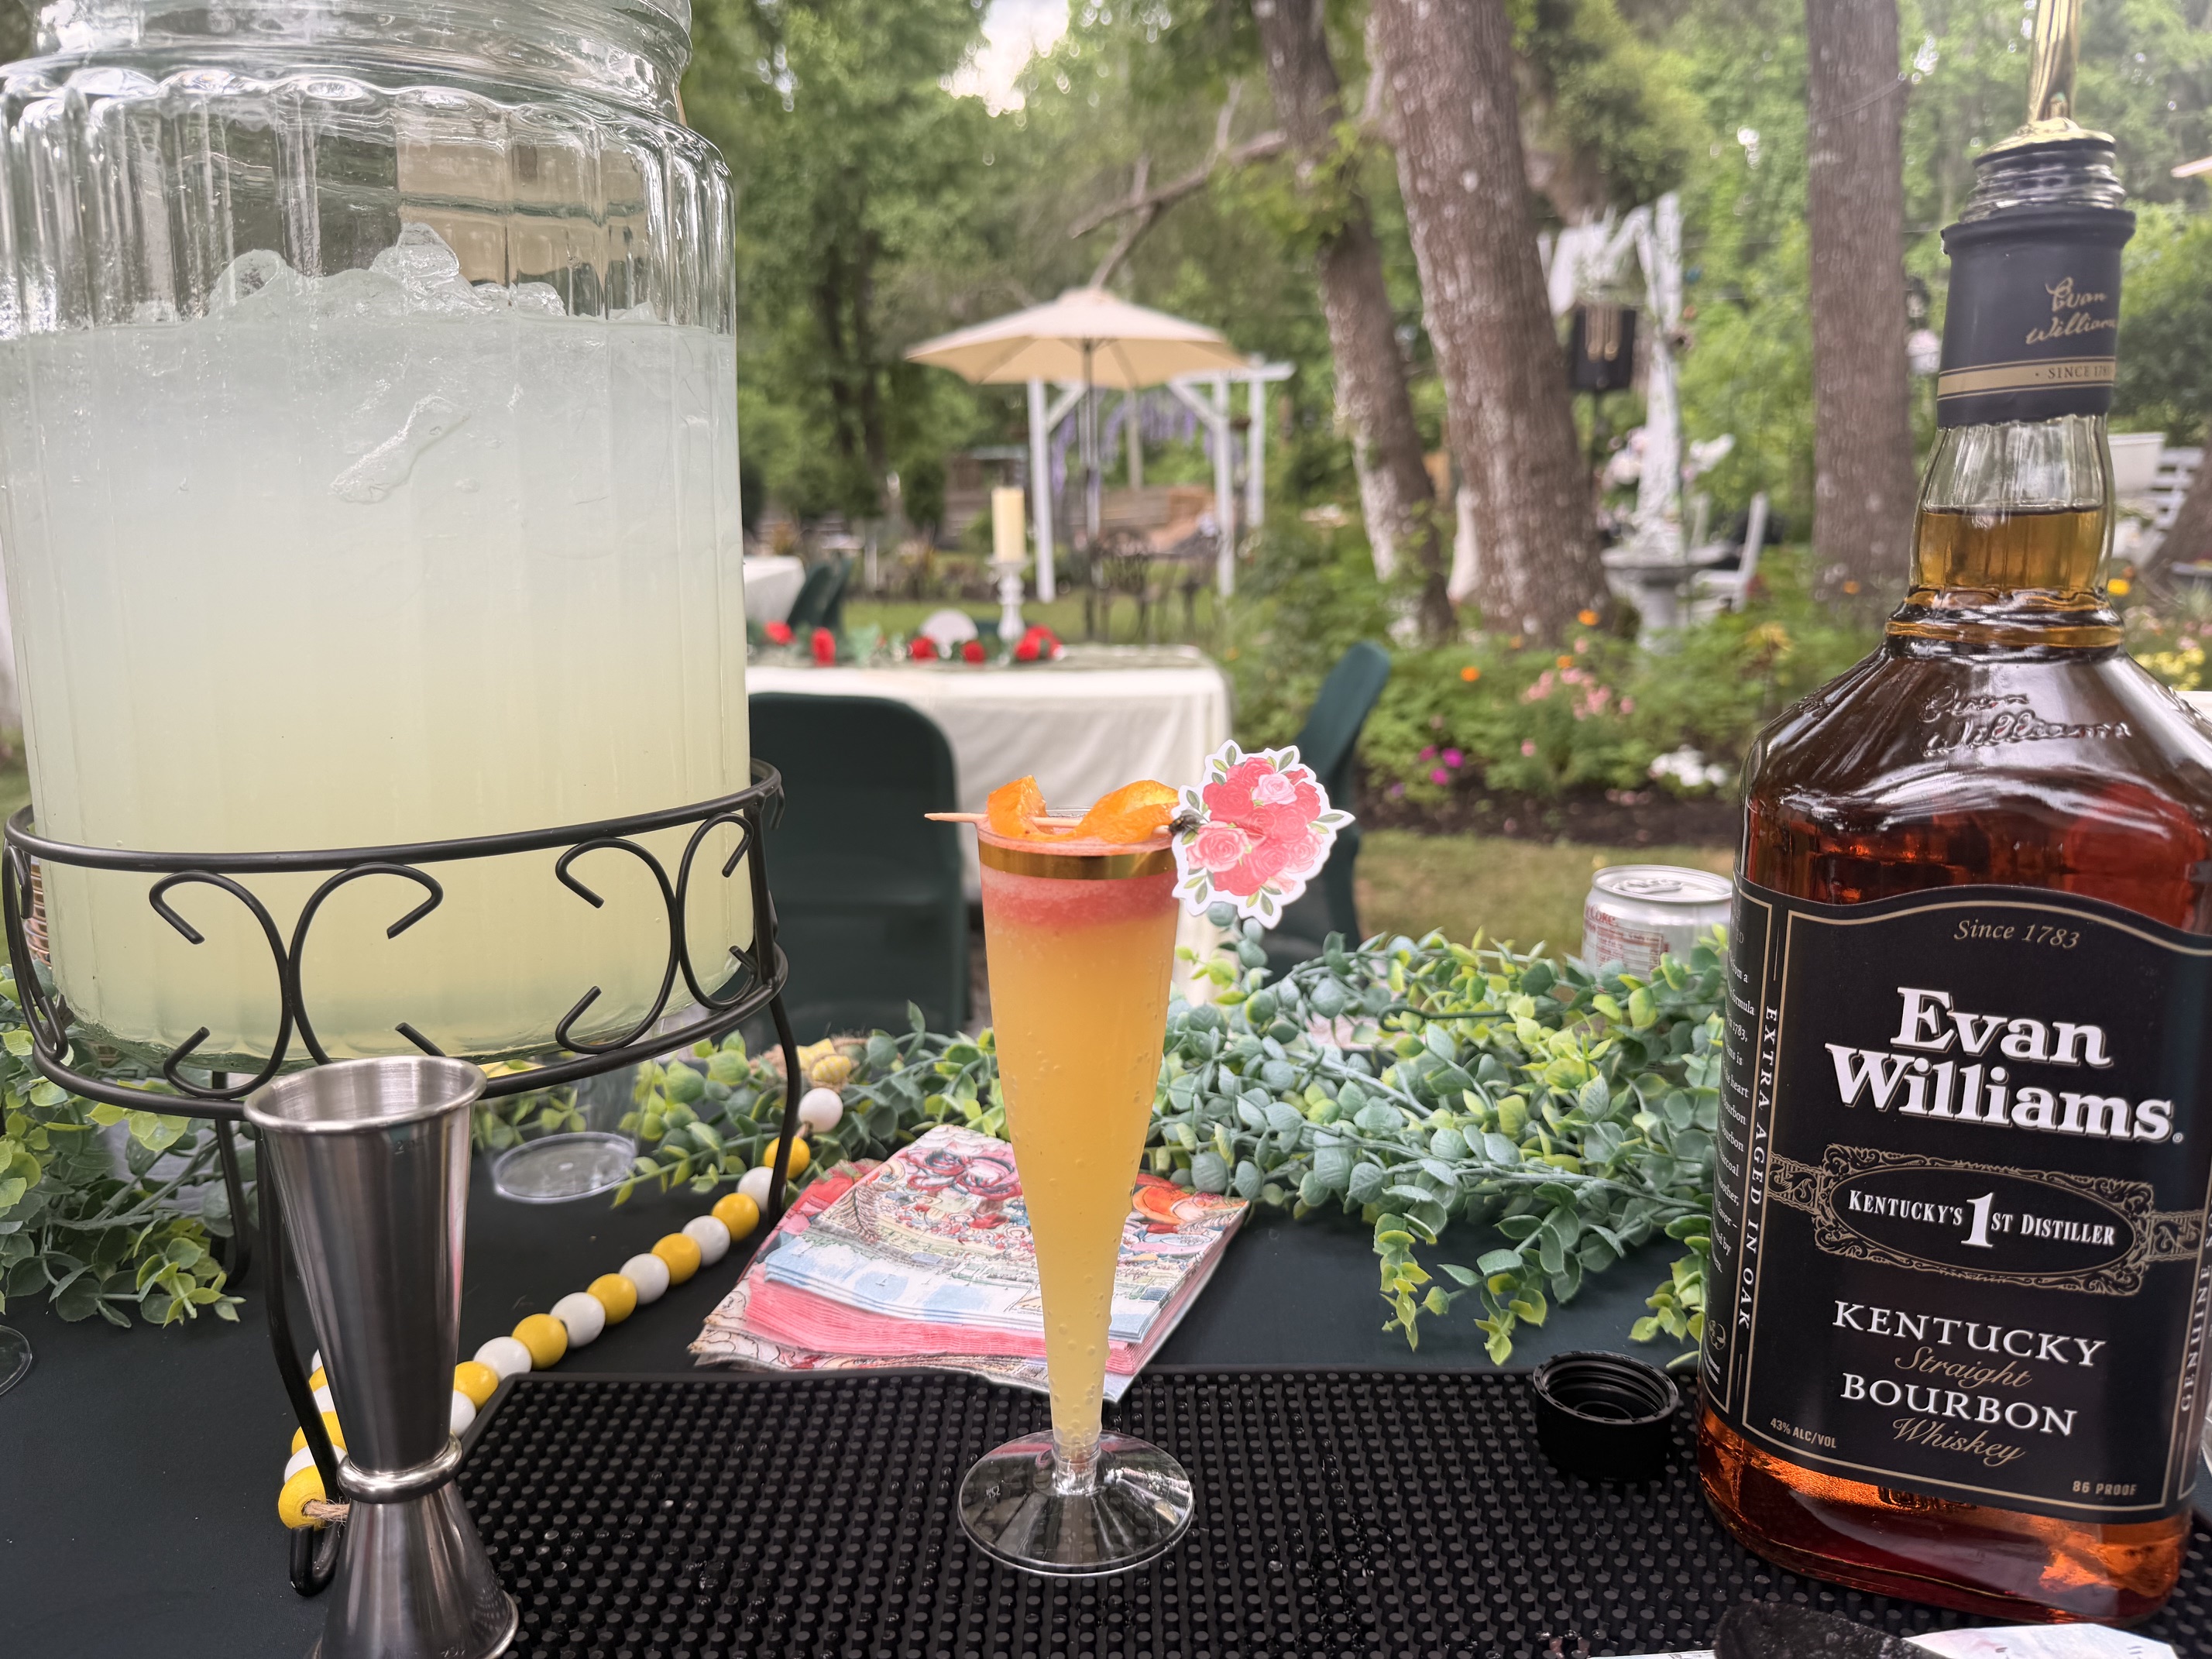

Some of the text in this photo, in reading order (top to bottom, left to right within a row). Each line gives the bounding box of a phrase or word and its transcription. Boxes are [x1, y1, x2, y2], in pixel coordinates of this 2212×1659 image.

[2045, 276, 2107, 311] Evan
[2048, 366, 2090, 380] SINCE
[1953, 919, 2080, 949] Since 1783
[1890, 987, 2114, 1069] Evan
[1739, 1006, 1778, 1330] EXTRA AGED IN OAK
[1832, 1300, 2107, 1366] KENTUCKY
[1894, 1346, 2032, 1389] Straight
[1840, 1372, 2078, 1437] BOURBON
[1770, 1417, 1837, 1449] 43% ALC/VOL
[1893, 1417, 2026, 1467] Whiskey
[2072, 1479, 2138, 1497] 86 PROOF
